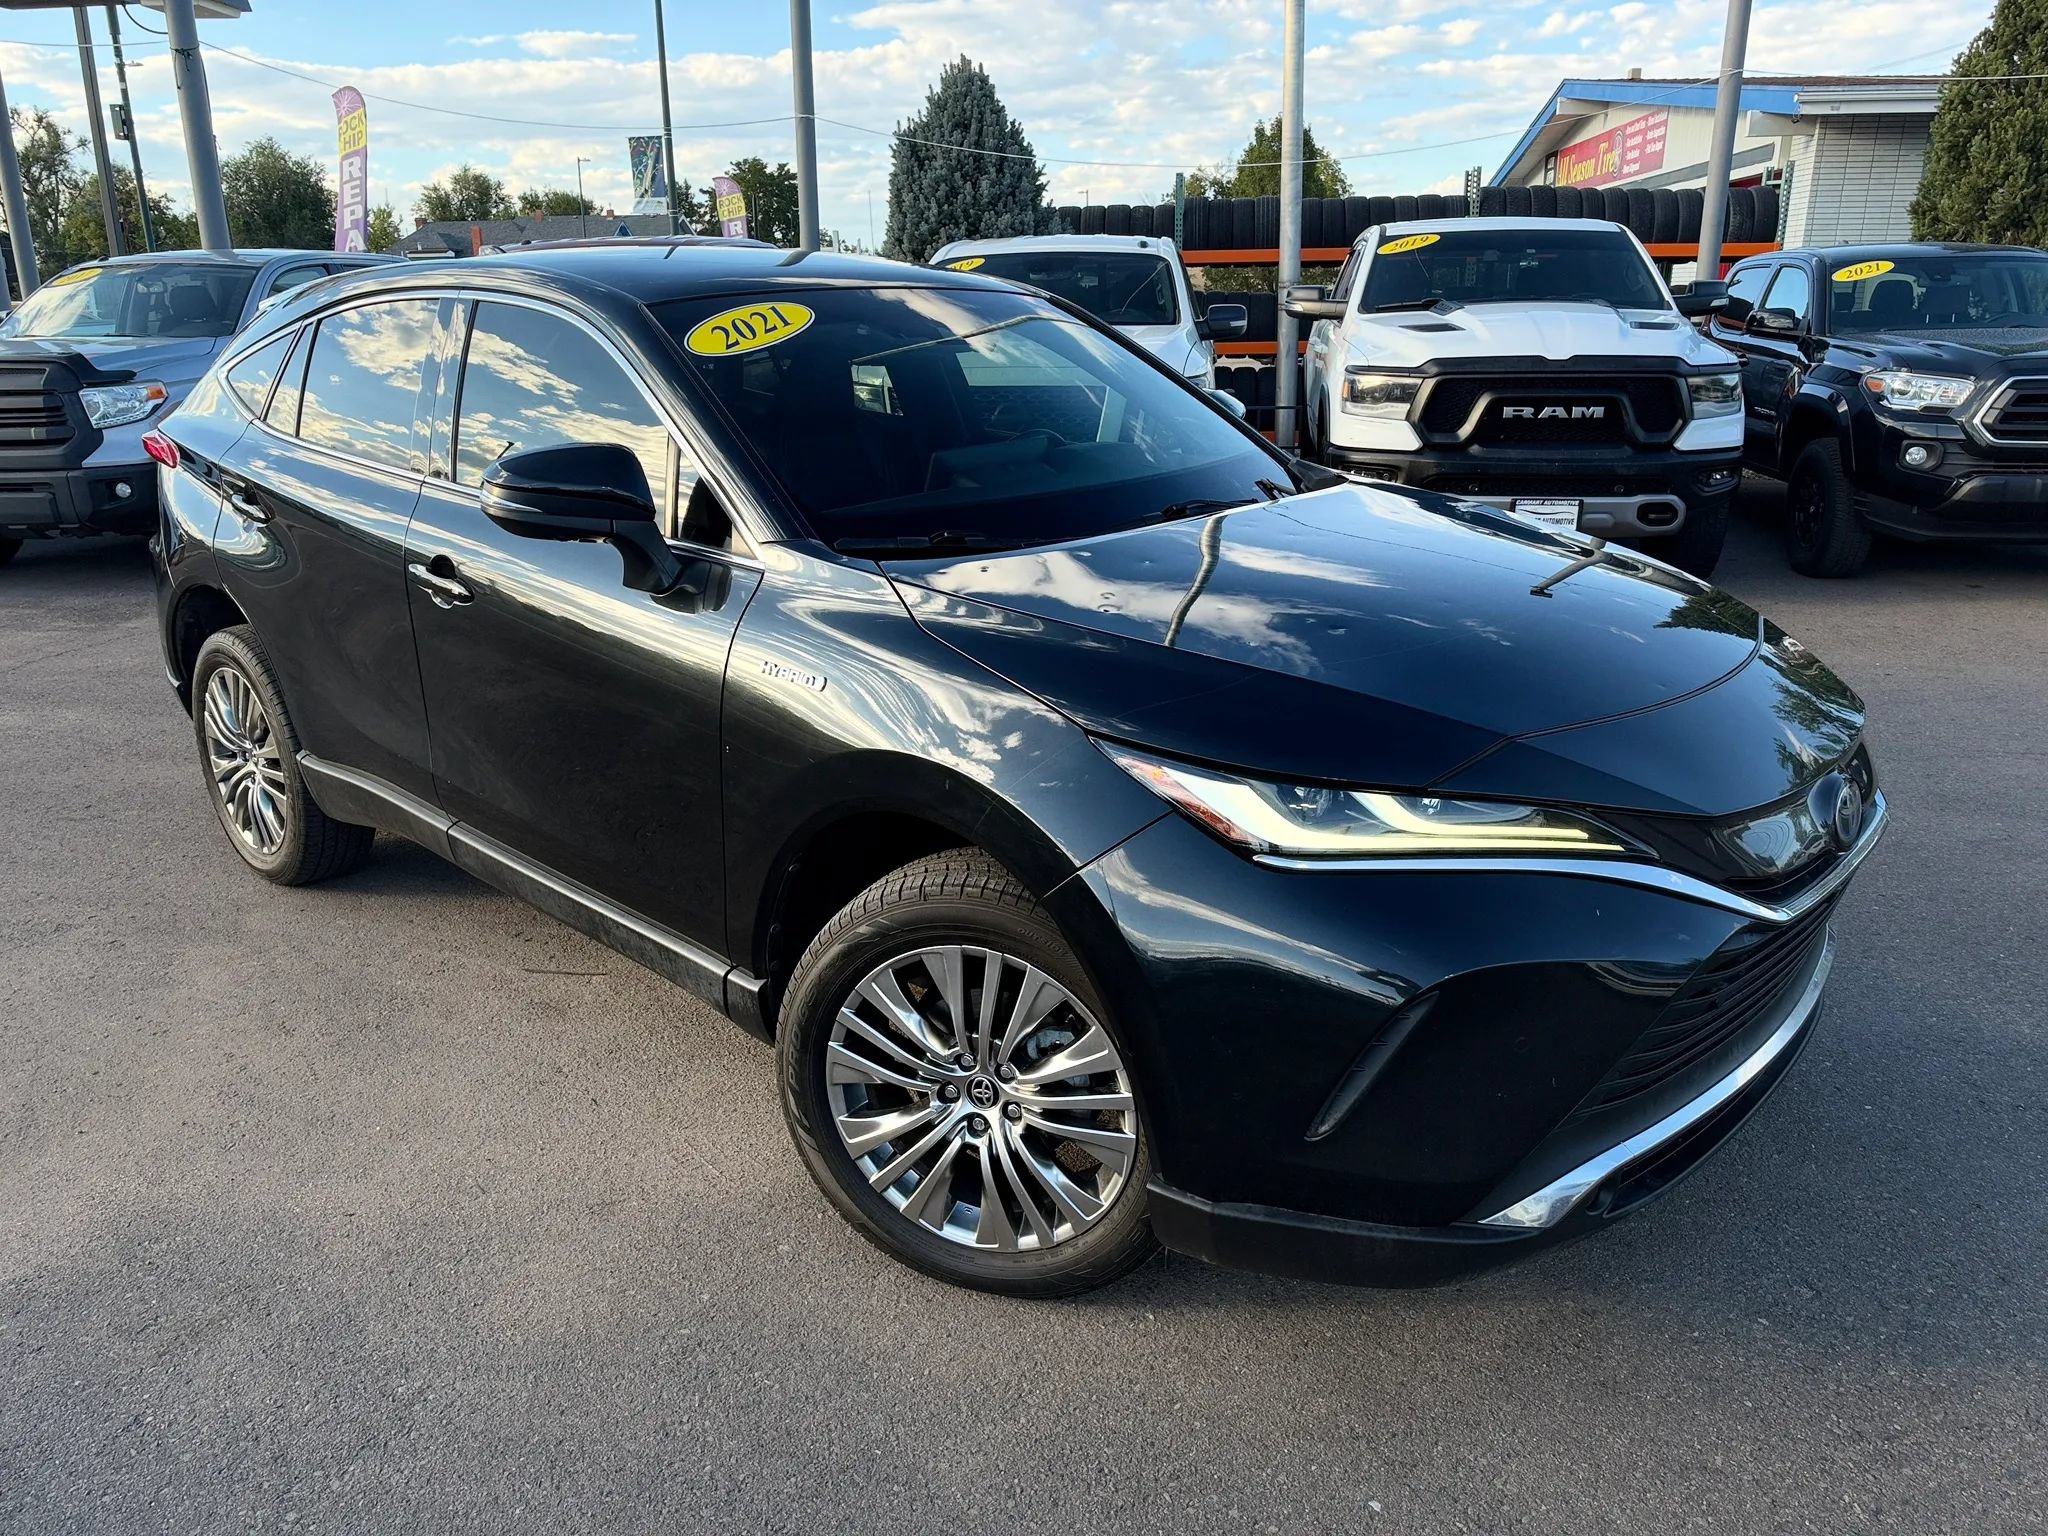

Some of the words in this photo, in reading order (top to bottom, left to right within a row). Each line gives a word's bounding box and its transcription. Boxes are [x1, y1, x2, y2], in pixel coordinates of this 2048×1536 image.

[339, 115, 365, 140] OCK
[343, 130, 364, 151] HIP
[1568, 154, 1596, 184] Season
[718, 195, 743, 211] ROCK
[721, 205, 743, 219] CHIP
[1390, 236, 1429, 251] 2019
[1845, 262, 1881, 279] 2021
[710, 305, 792, 351] 2021
[1503, 406, 1605, 419] RAM
[1542, 518, 1575, 526] AUTOMOTIVE
[760, 660, 816, 687] HYBRID
